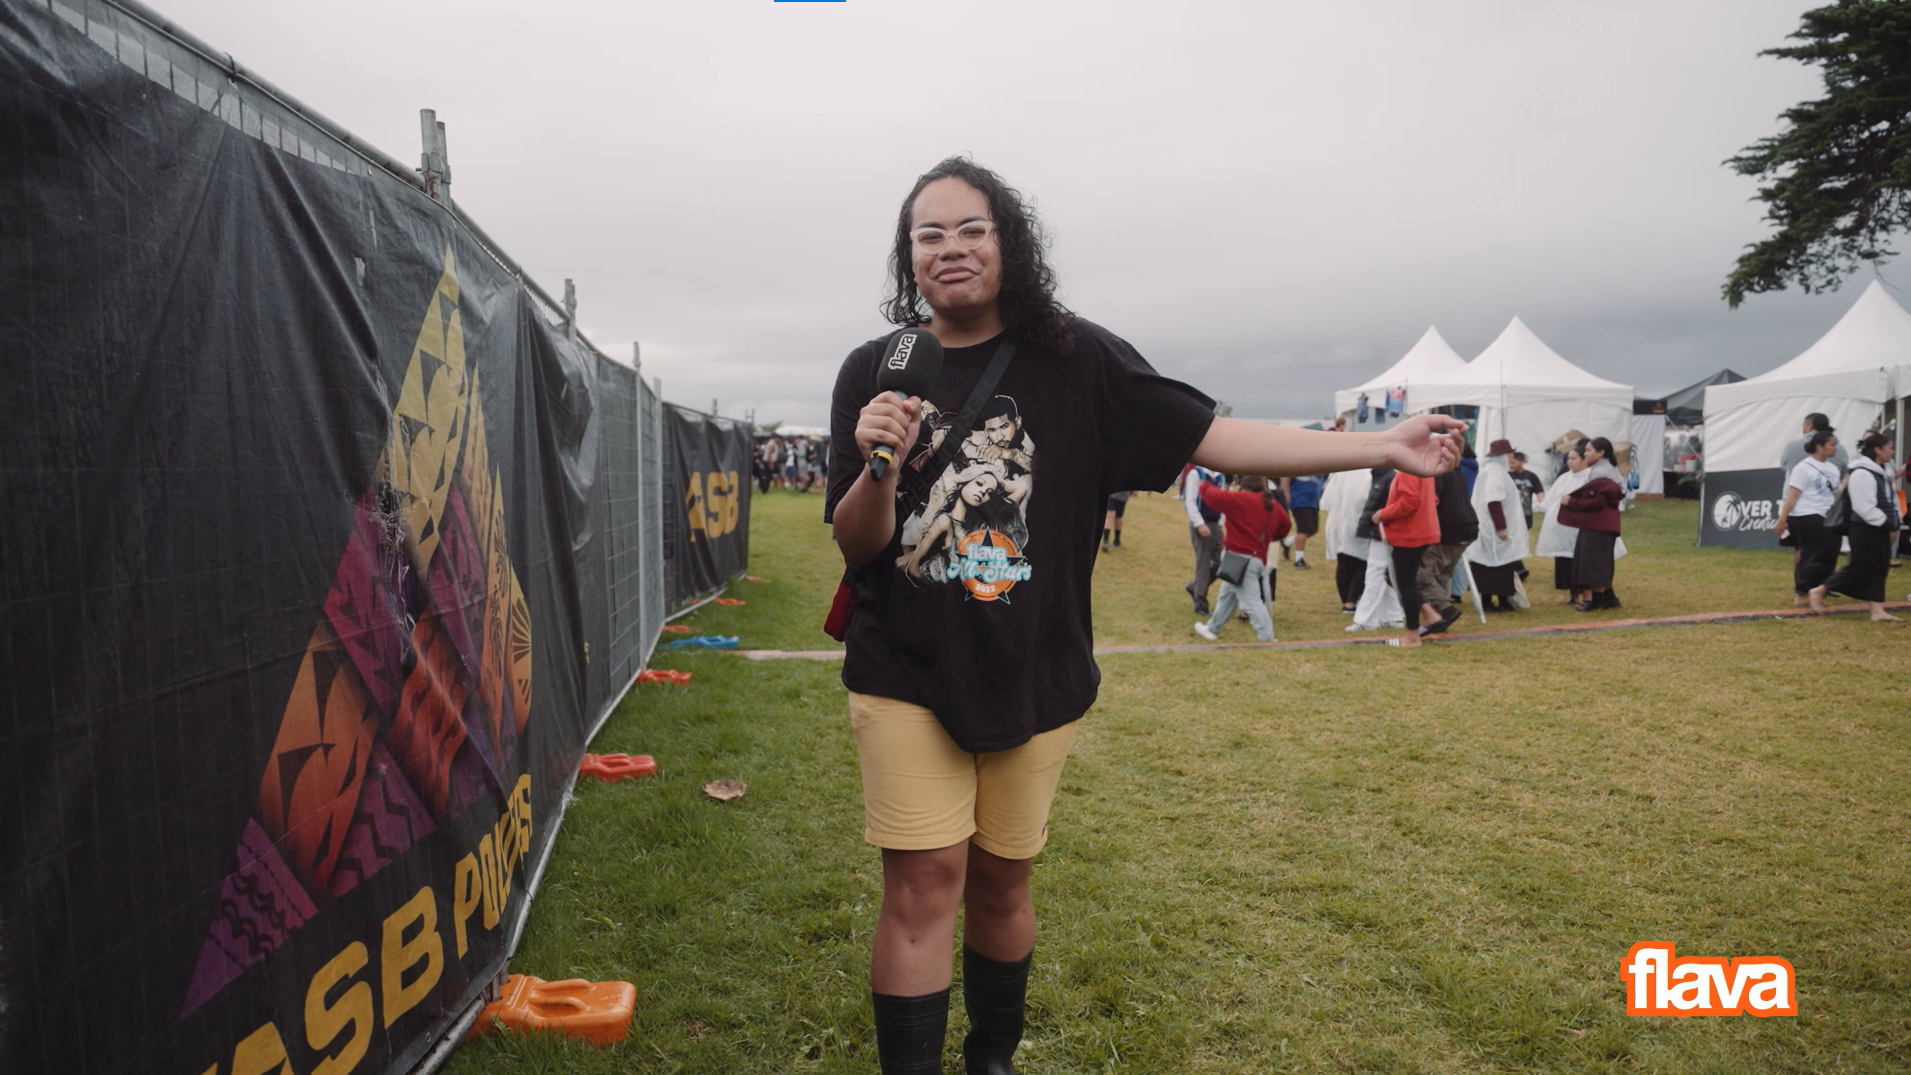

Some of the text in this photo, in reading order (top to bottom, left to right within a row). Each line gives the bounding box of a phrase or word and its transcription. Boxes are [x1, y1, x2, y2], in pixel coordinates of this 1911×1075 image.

[888, 335, 916, 369] flava
[686, 471, 739, 542] ASB
[967, 542, 1007, 561] flava
[975, 583, 996, 593] 2022
